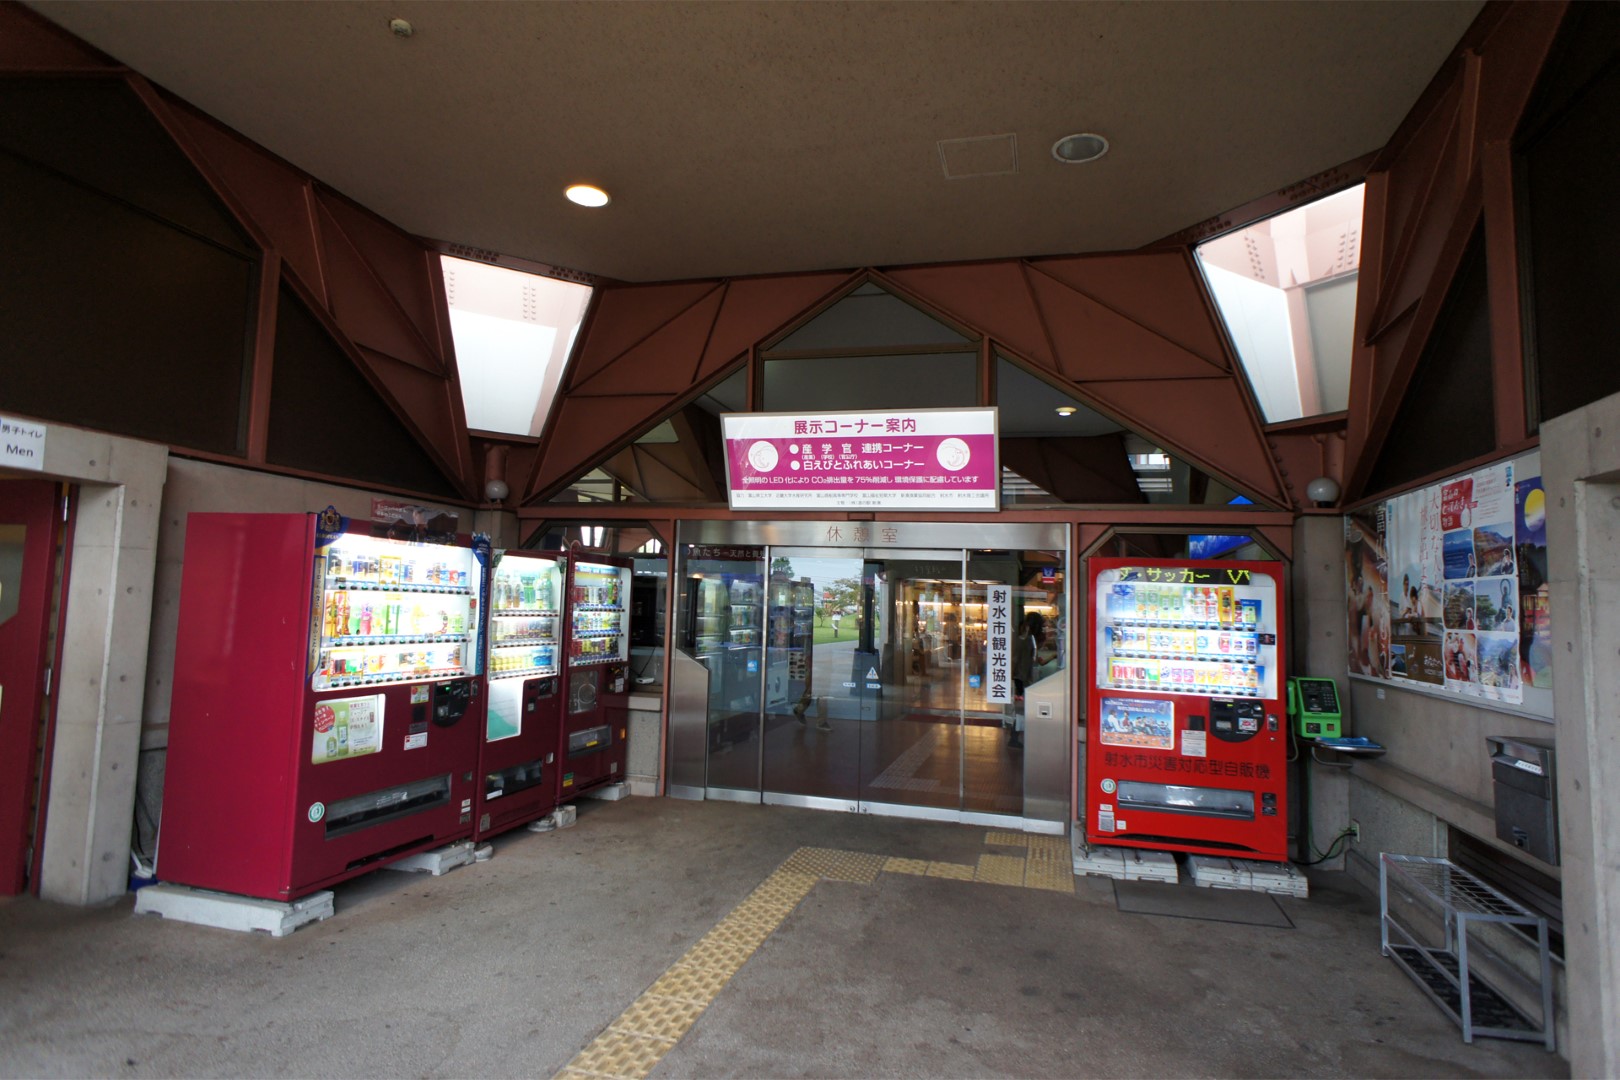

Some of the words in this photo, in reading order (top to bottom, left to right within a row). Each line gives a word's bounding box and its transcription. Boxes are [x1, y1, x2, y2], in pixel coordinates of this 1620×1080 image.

[794, 418, 917, 434] 展示コーナー案内
[6, 444, 33, 457] Men
[803, 460, 925, 471] 白えびとふれあいコーナー
[827, 525, 898, 543] 休憩室
[992, 589, 1007, 698] 射水市観光協会
[1104, 751, 1272, 780] 射水市災害対応型自販機
